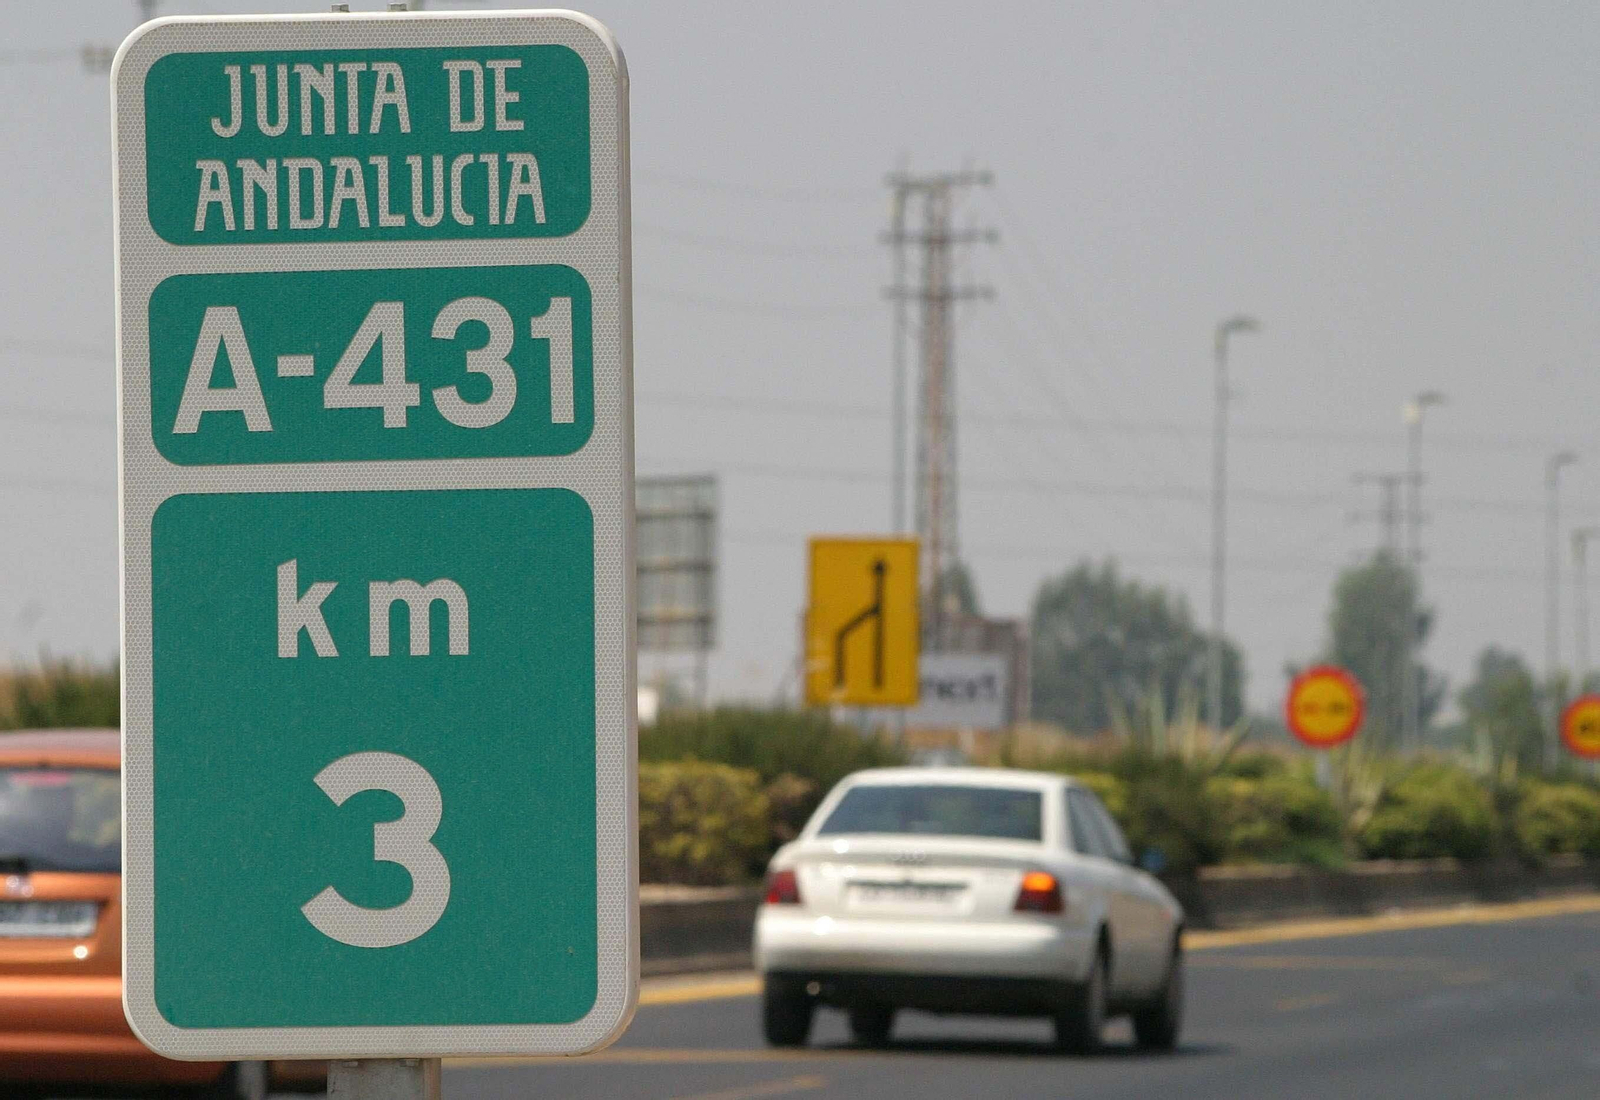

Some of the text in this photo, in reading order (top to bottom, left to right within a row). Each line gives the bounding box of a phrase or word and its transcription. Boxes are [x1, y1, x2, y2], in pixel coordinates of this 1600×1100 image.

[211, 59, 525, 138] JUNTA DE
[194, 152, 546, 231] ANDALUCIA
[172, 296, 575, 434] A-431
[277, 558, 469, 658] km
[301, 751, 451, 948] 3
